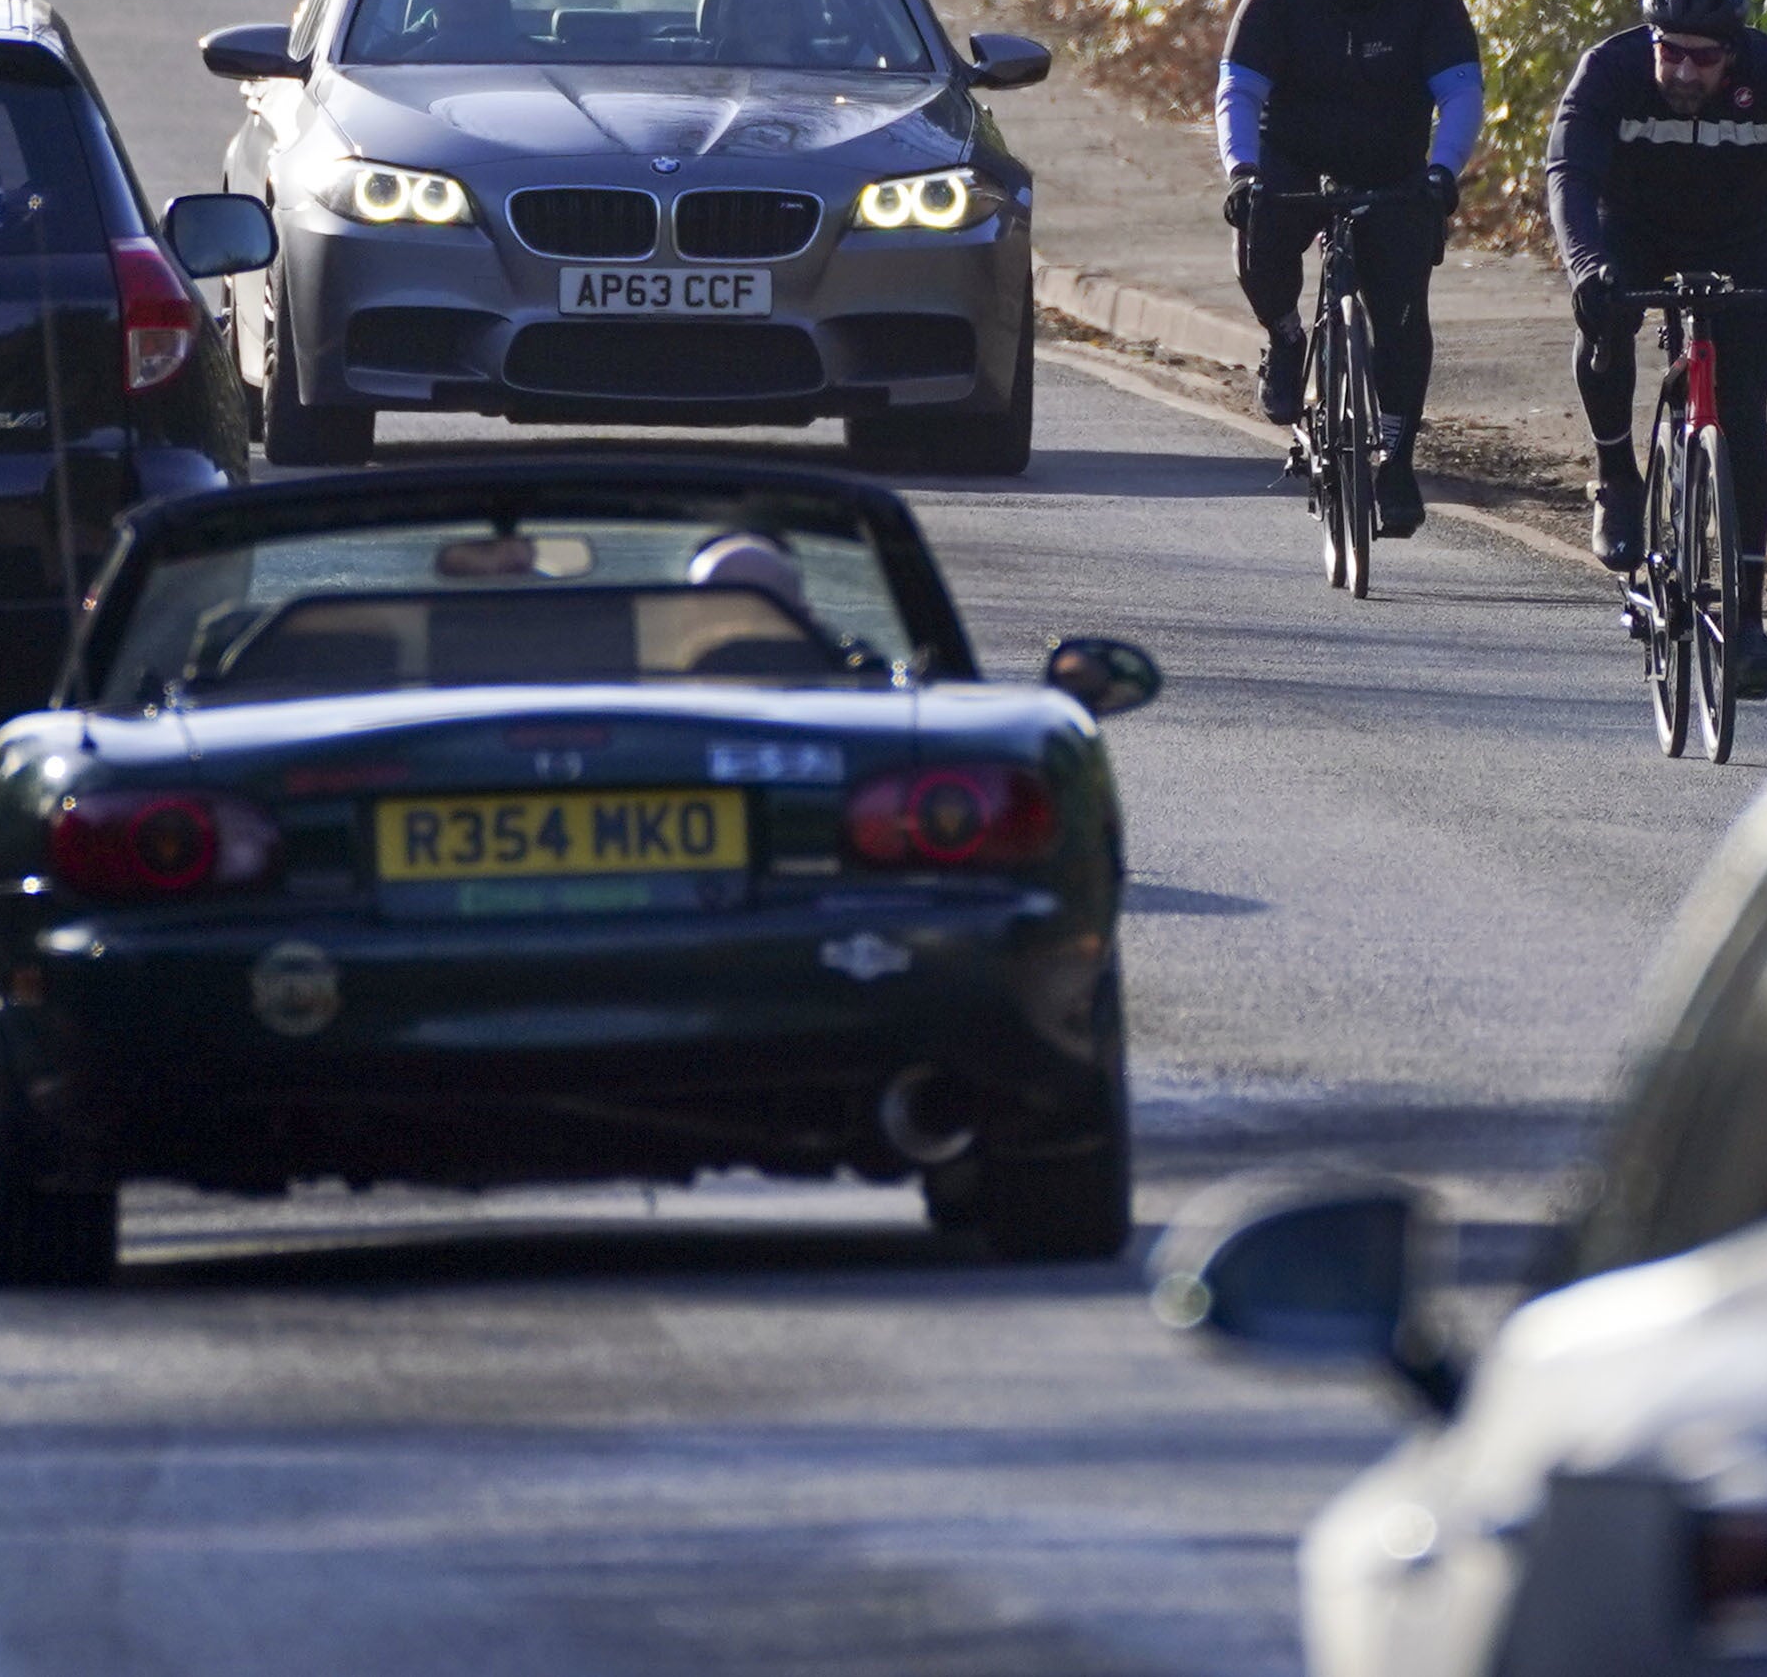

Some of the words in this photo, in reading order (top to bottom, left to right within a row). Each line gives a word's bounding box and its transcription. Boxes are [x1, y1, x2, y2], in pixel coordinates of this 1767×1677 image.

[577, 274, 672, 308] AP63
[685, 275, 755, 308] CCF
[404, 805, 571, 867] R354
[591, 800, 717, 861] MKO
